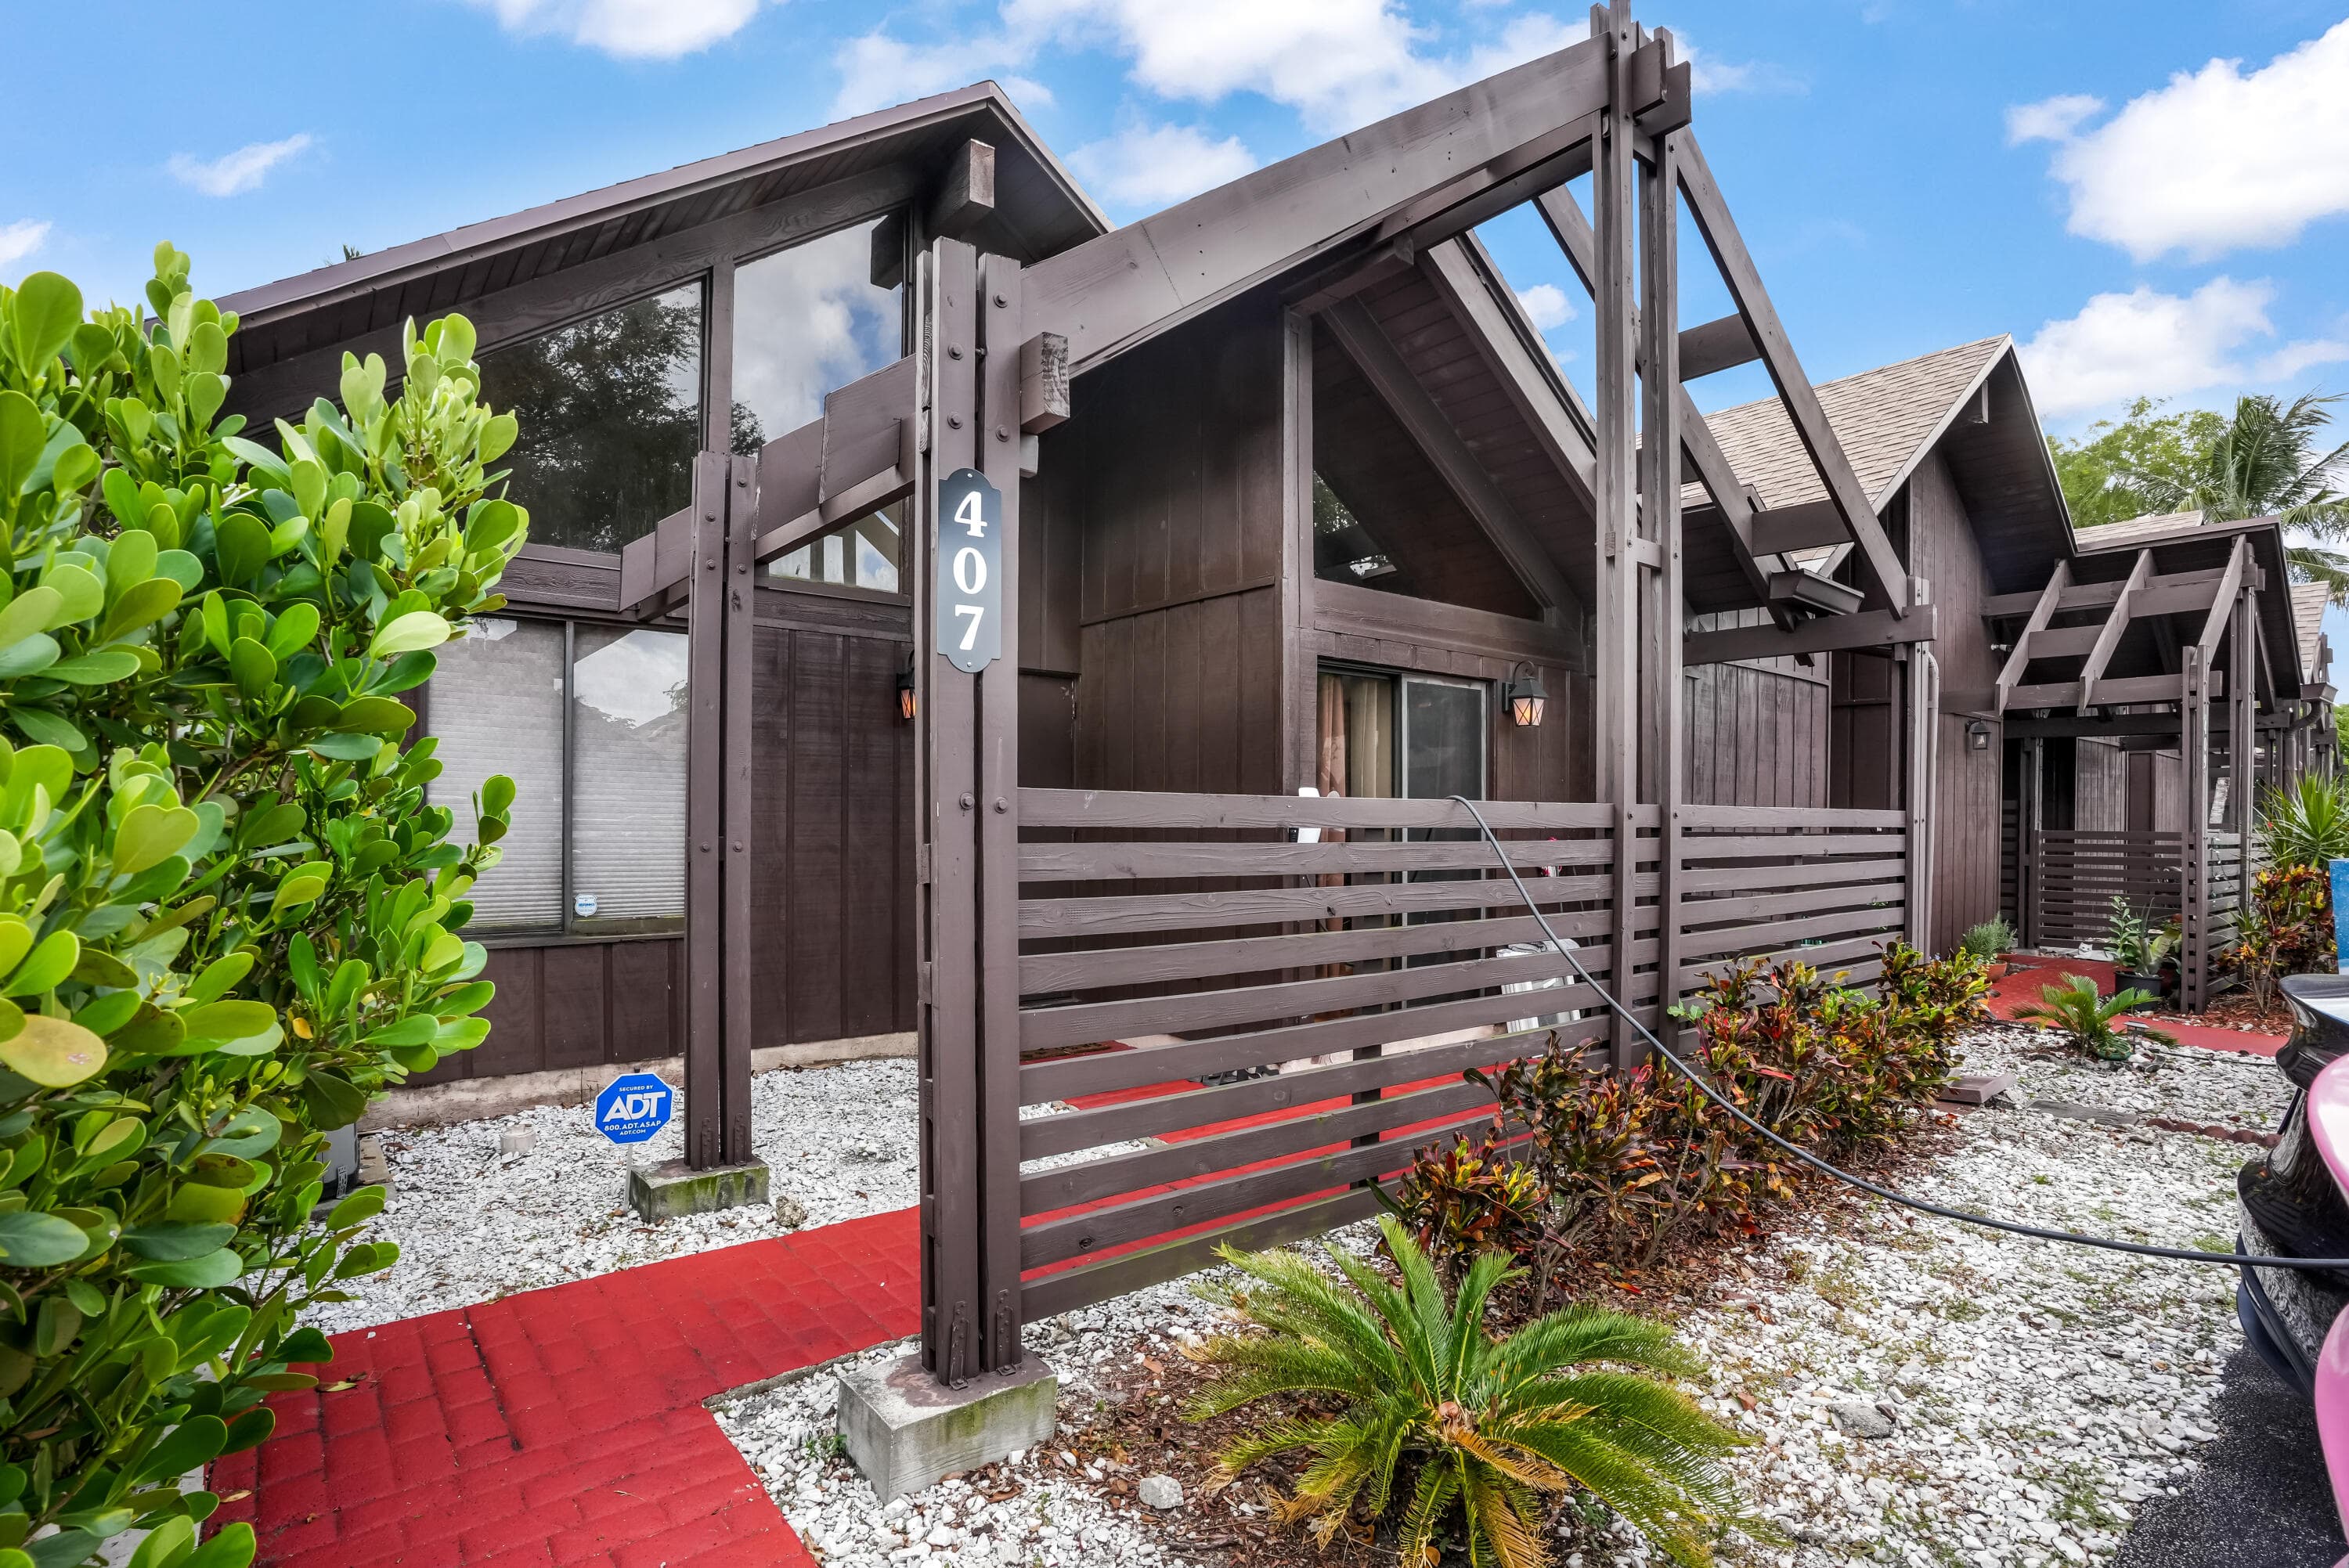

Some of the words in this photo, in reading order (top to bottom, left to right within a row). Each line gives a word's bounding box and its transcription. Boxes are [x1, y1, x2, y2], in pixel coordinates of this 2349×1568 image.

[953, 491, 988, 651] 407
[602, 1091, 666, 1123] ADT
[604, 1120, 662, 1131] 800.ADT.ASAP
